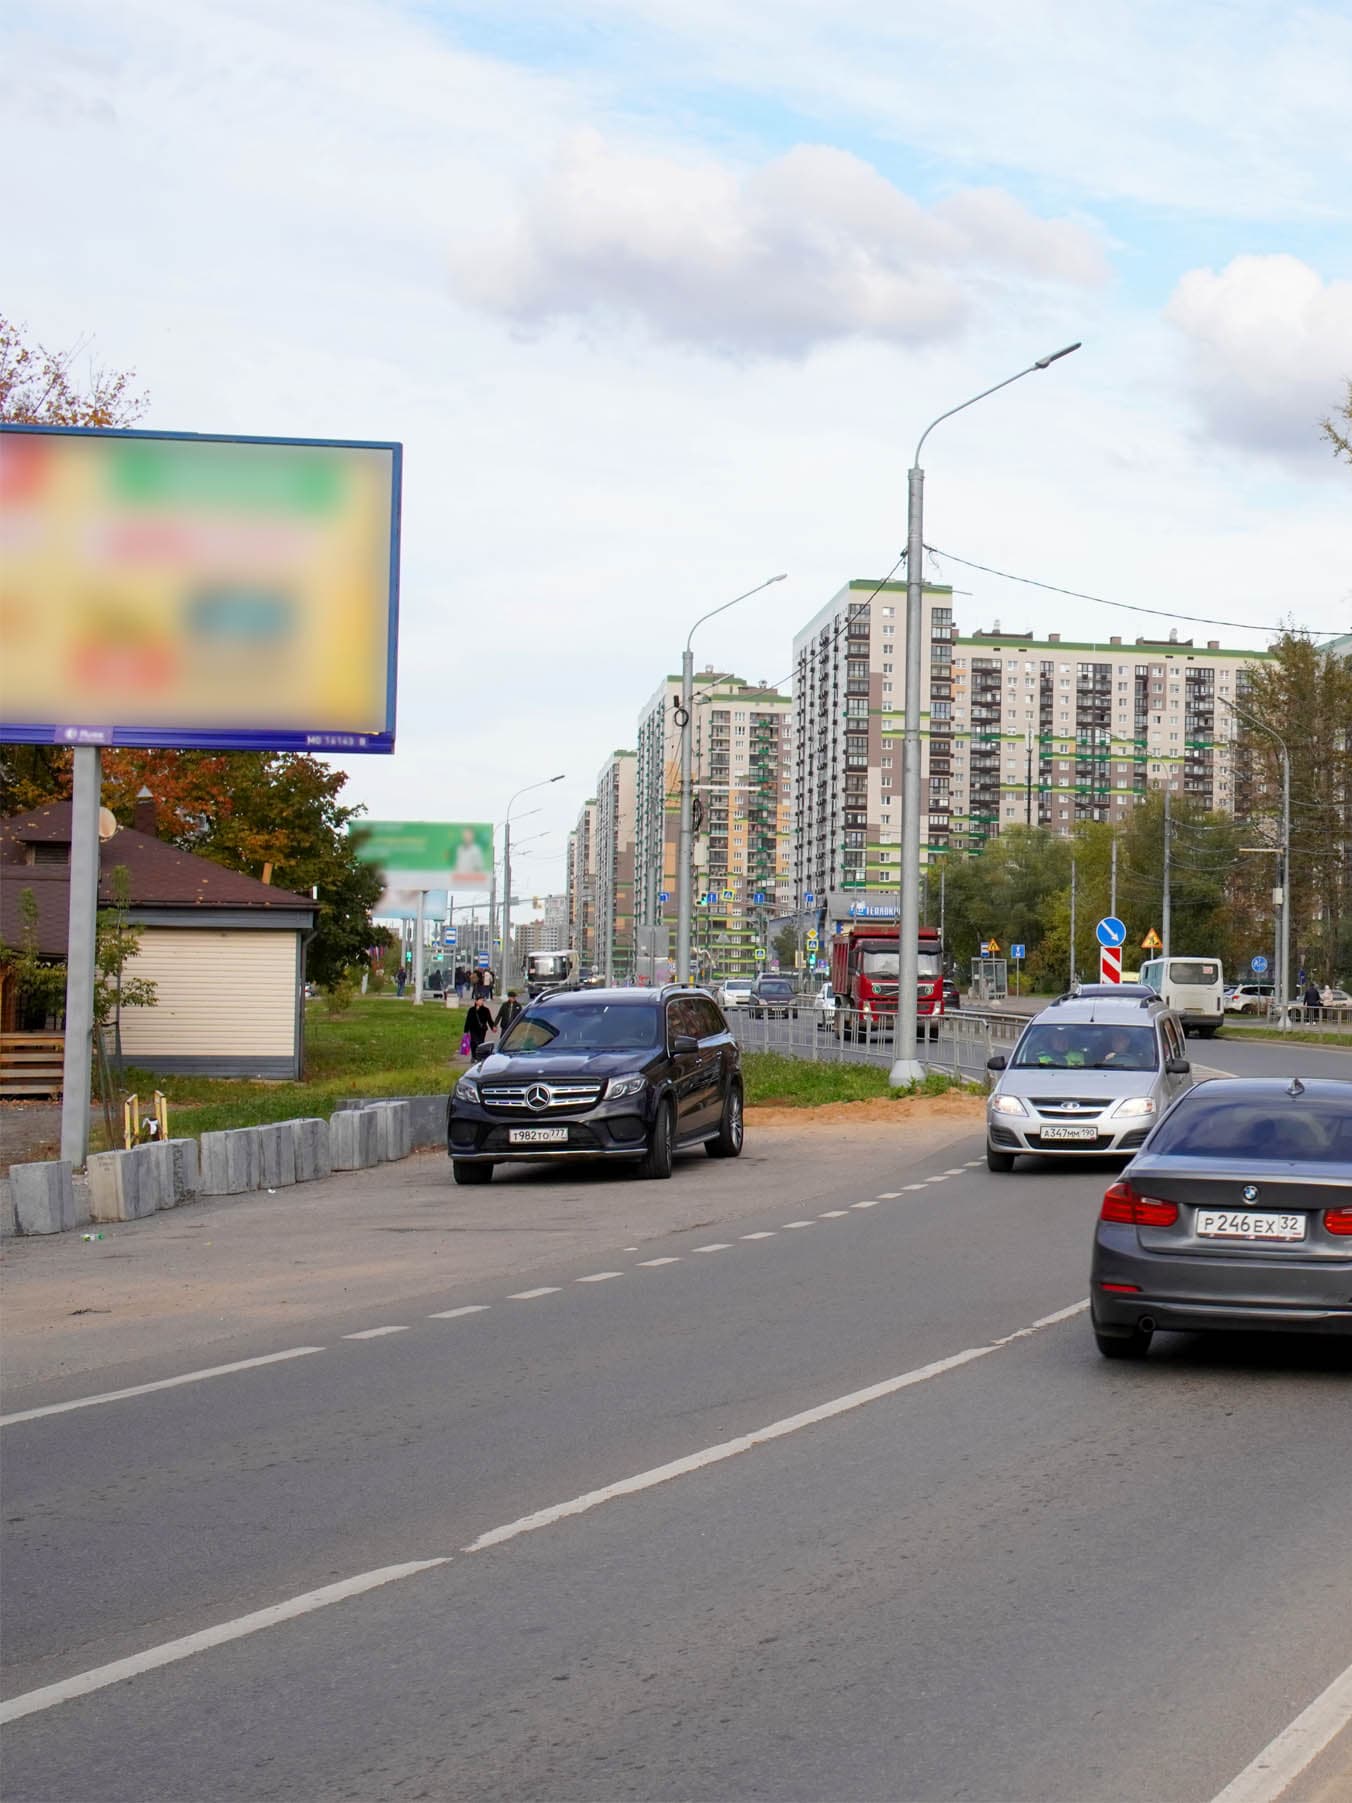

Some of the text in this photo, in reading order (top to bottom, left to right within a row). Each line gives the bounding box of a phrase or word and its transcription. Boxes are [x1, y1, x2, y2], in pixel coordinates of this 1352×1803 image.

[513, 1130, 549, 1140] Т982ТО
[1204, 1214, 1298, 1234] Р246ЕХ 32
